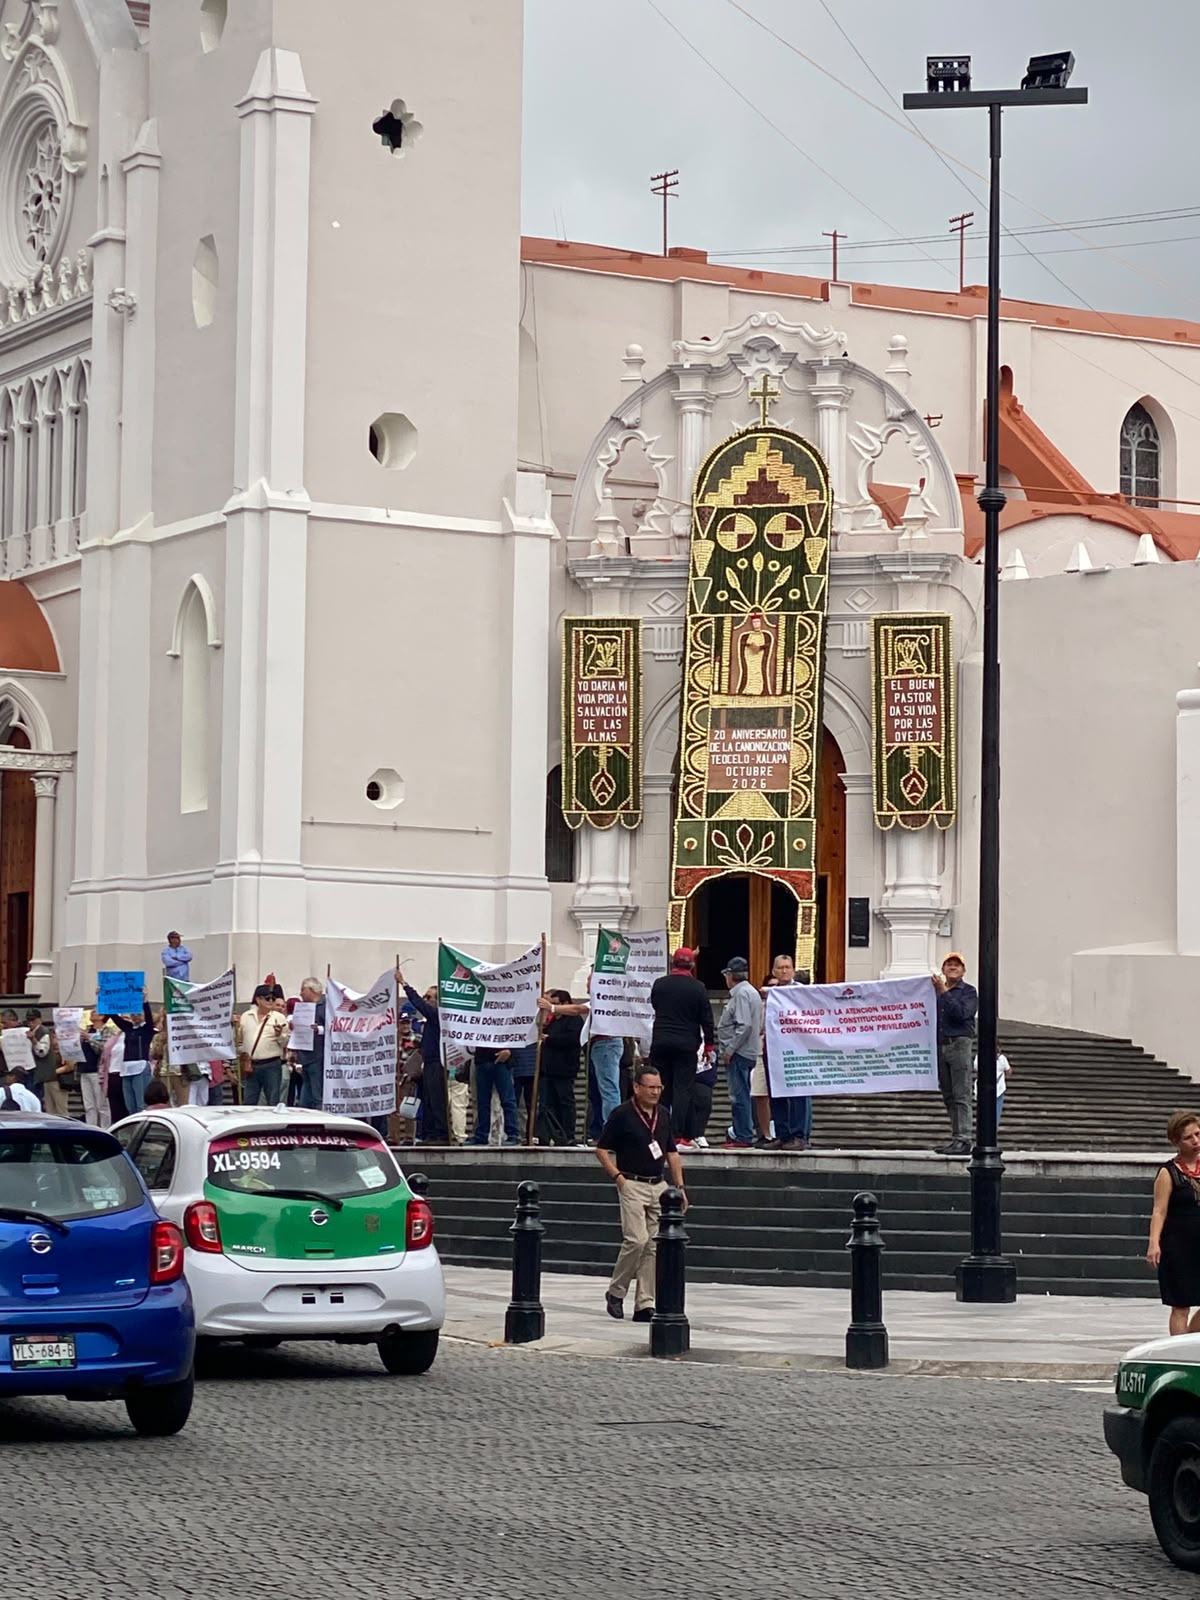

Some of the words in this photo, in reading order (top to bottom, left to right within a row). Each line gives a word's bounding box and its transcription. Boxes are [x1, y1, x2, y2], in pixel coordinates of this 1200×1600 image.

[578, 681, 588, 691] YO
[591, 681, 616, 691] DARIA
[619, 681, 628, 691] MI
[891, 680, 903, 690] EL
[909, 679, 934, 690] BUEN
[578, 694, 596, 704] VIDA
[598, 694, 614, 704] POR
[616, 694, 628, 704] LA
[894, 692, 932, 703] PASTOR
[578, 705, 628, 717] SALVACIÓN
[890, 706, 901, 716] DA
[904, 706, 915, 716] SU
[918, 705, 937, 716] VIDA
[583, 719, 596, 730] DE
[604, 719, 622, 730] LAS
[894, 719, 912, 728] POR
[916, 718, 933, 728] LAS
[588, 732, 617, 742] ALMAS
[714, 730, 726, 740] 20
[732, 729, 787, 740] ANIVERSARIO
[895, 731, 932, 742] OVEJAS
[710, 742, 720, 752] DE
[722, 742, 733, 752] LA
[726, 766, 774, 776] OCTUBRE
[732, 779, 766, 788] 2026
[880, 1003, 908, 1012] MEDICA
[910, 1002, 925, 1010] SON
[470, 1016, 480, 1024] EN
[838, 1013, 904, 1024] CONSTITUCIONALES
[877, 1020, 922, 1030] PRIVILEGIOS
[464, 1032, 476, 1040] DE
[476, 1033, 492, 1042] UNA
[250, 1136, 299, 1146] REGION
[301, 1136, 349, 1146] XALAPA
[212, 1152, 281, 1173] XL-9594
[232, 1244, 266, 1253] MARCH
[14, 1344, 74, 1359] YLS-684-B
